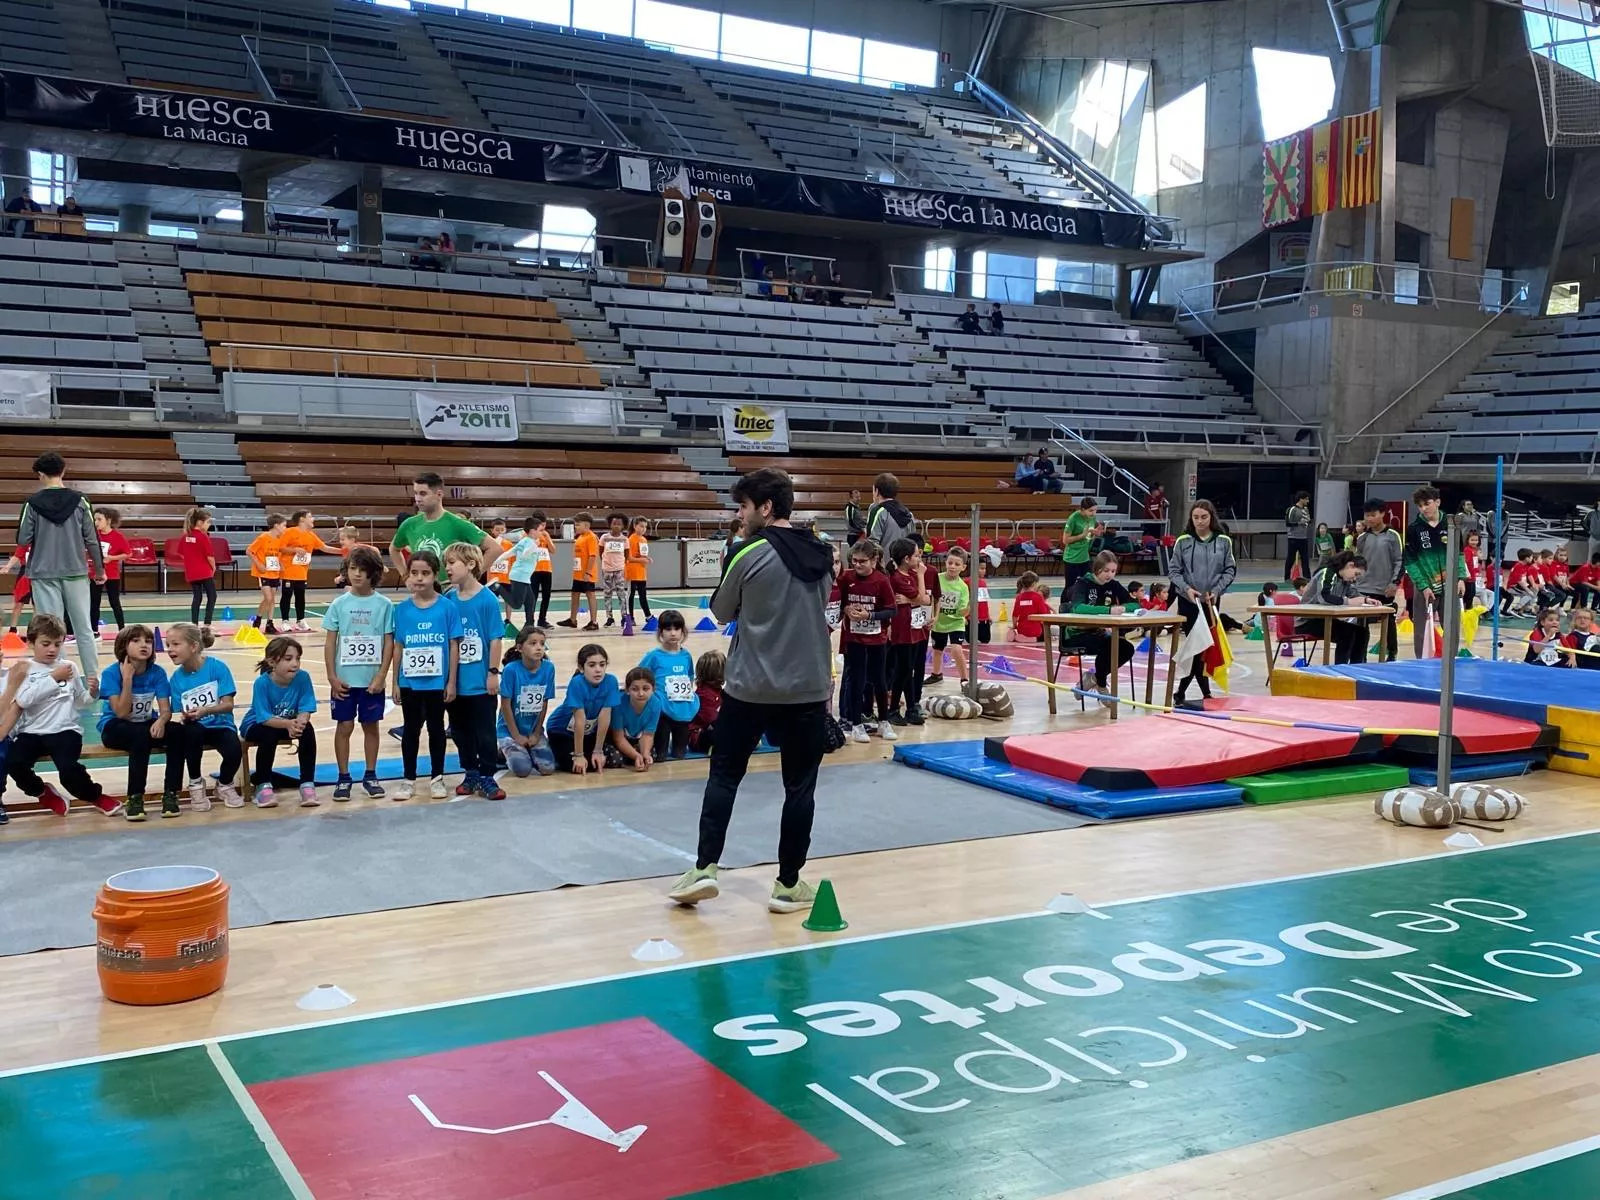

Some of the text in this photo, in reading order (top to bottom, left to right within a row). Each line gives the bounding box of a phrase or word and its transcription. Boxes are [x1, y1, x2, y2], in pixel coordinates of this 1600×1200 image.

[458, 404, 510, 412] ATLETISMO
[460, 412, 511, 428] ZOITI
[417, 622, 432, 630] CEIP
[348, 643, 375, 656] 393
[460, 643, 477, 656] 95
[409, 655, 435, 668] 394
[190, 691, 215, 710] 391
[527, 693, 542, 705] 39
[130, 700, 152, 714] 90
[713, 898, 1535, 1057] de Deportes
[806, 962, 1539, 1146] Municipal
